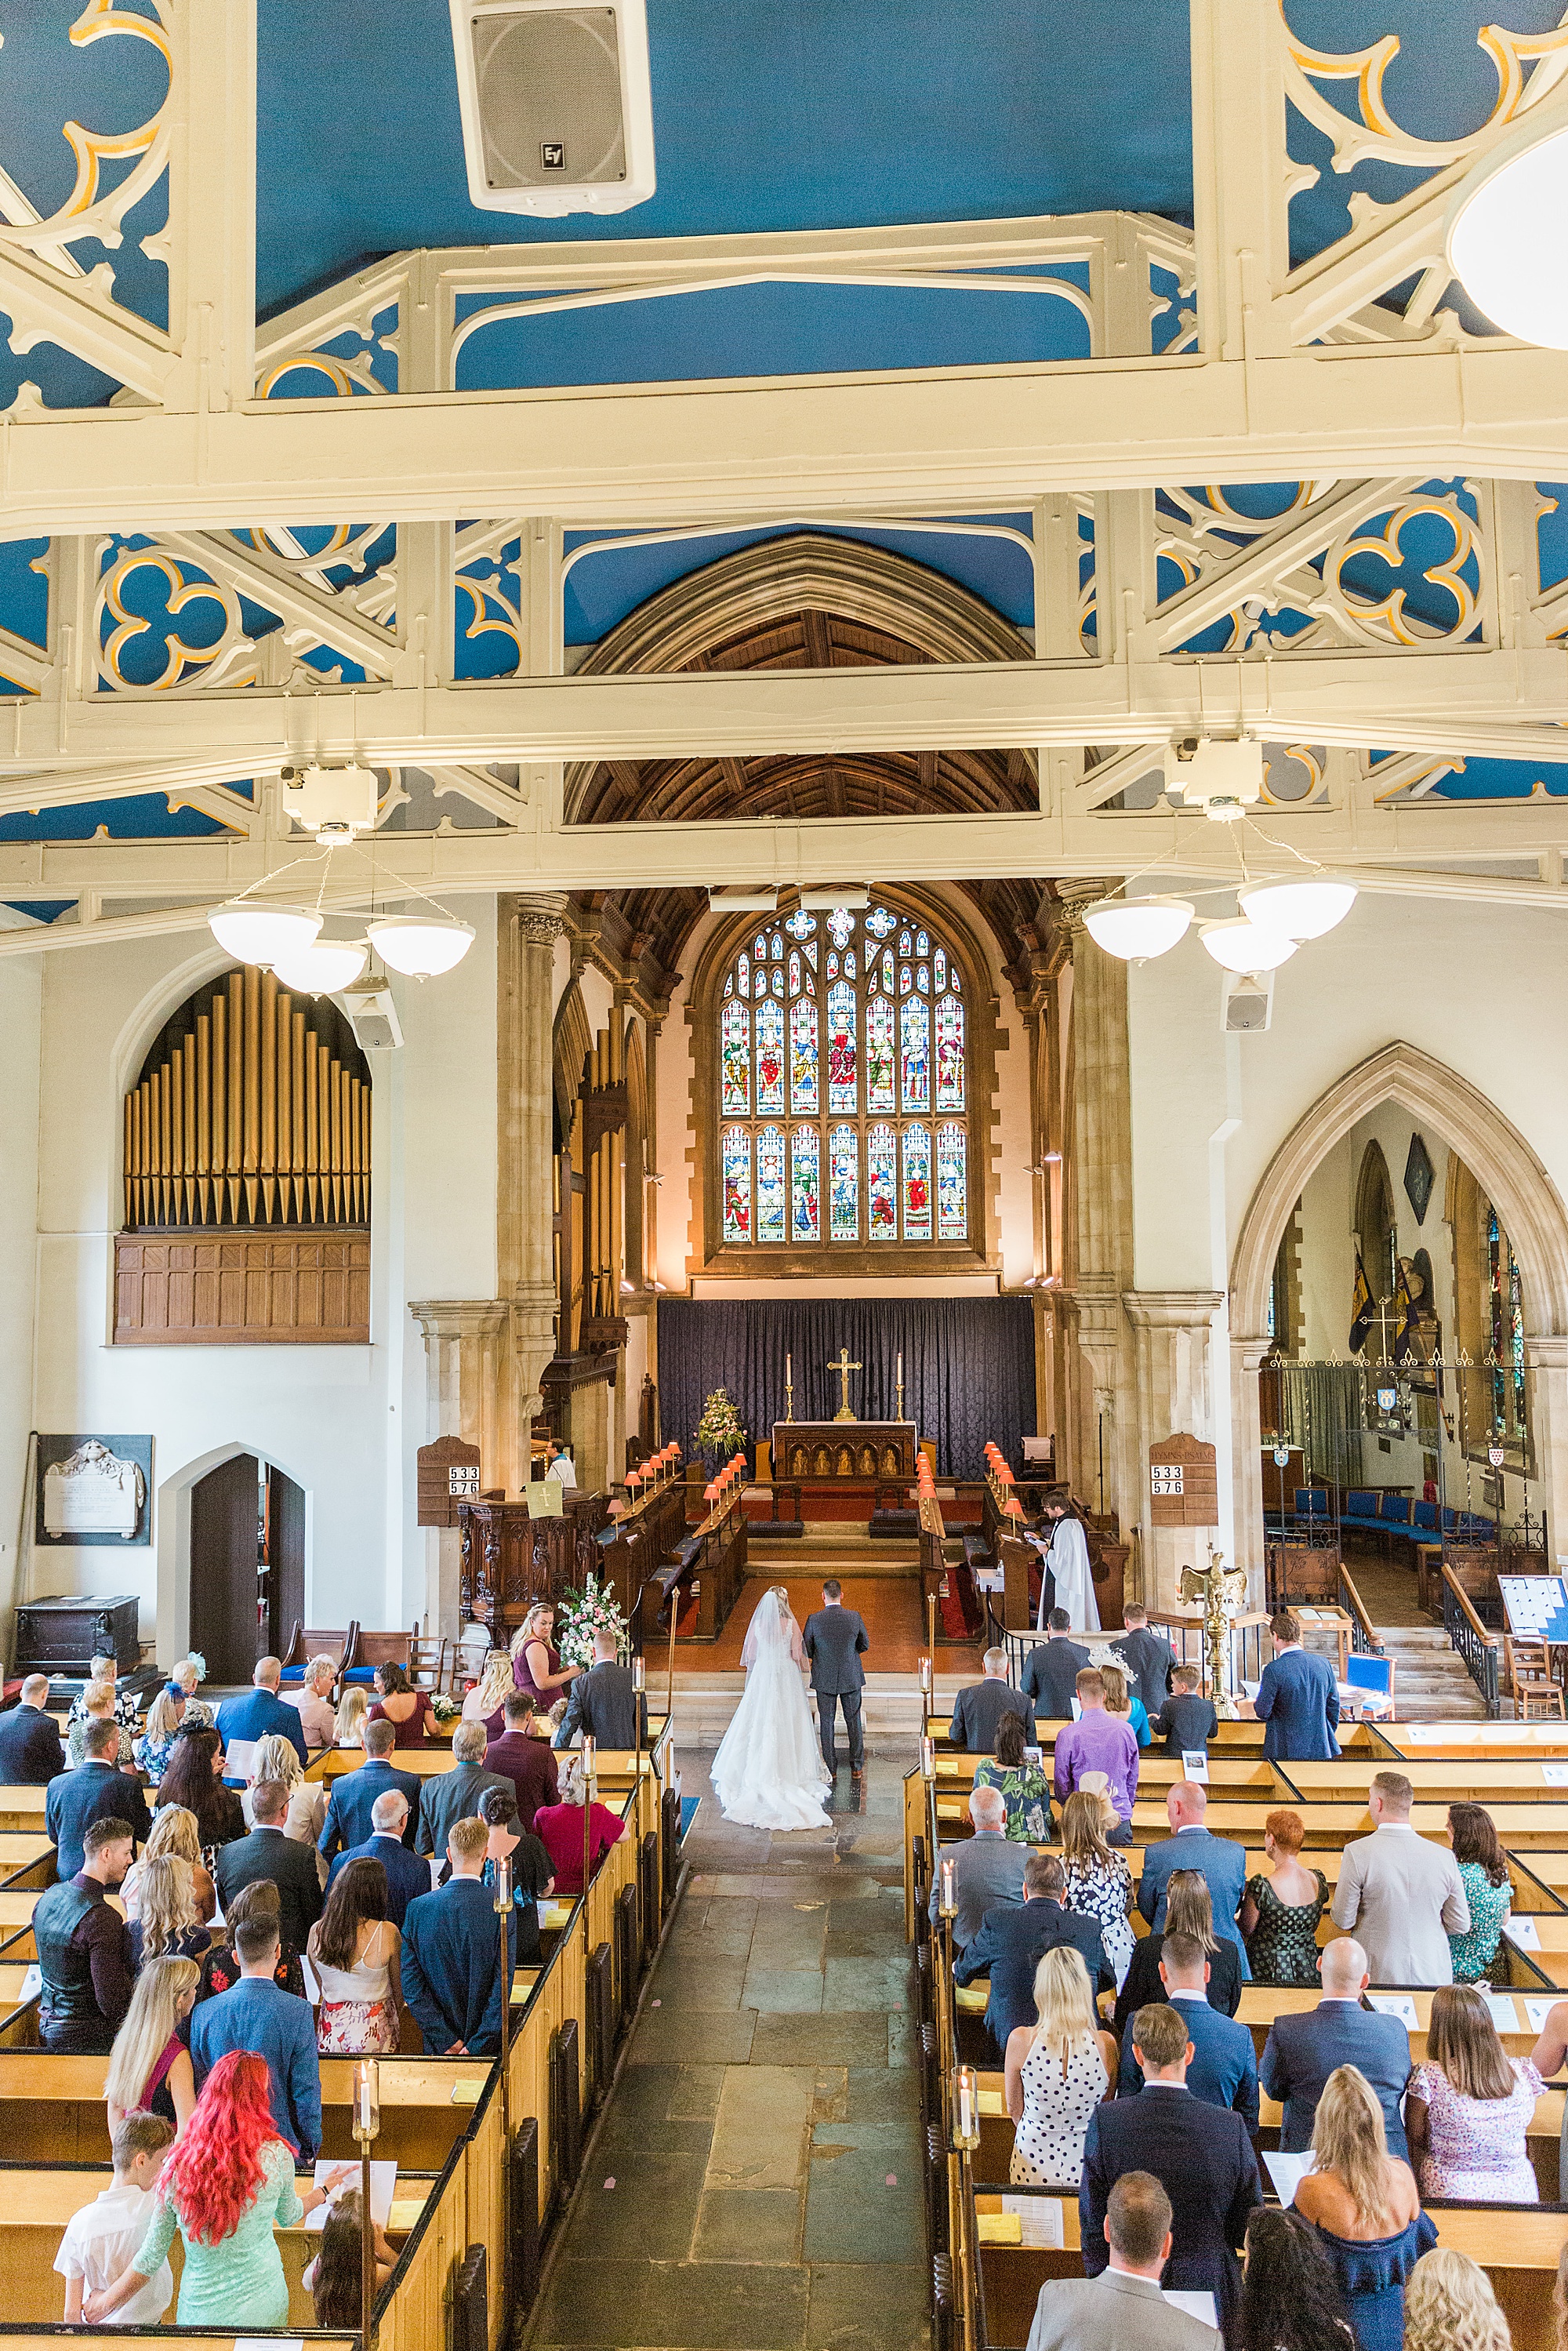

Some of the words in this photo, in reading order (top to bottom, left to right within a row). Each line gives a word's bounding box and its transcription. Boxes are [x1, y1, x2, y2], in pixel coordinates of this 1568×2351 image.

[545, 147, 561, 164] EV
[451, 1468, 477, 1479] 533
[1153, 1466, 1181, 1478] 533
[451, 1482, 477, 1494] 576
[1154, 1482, 1181, 1493] 576
